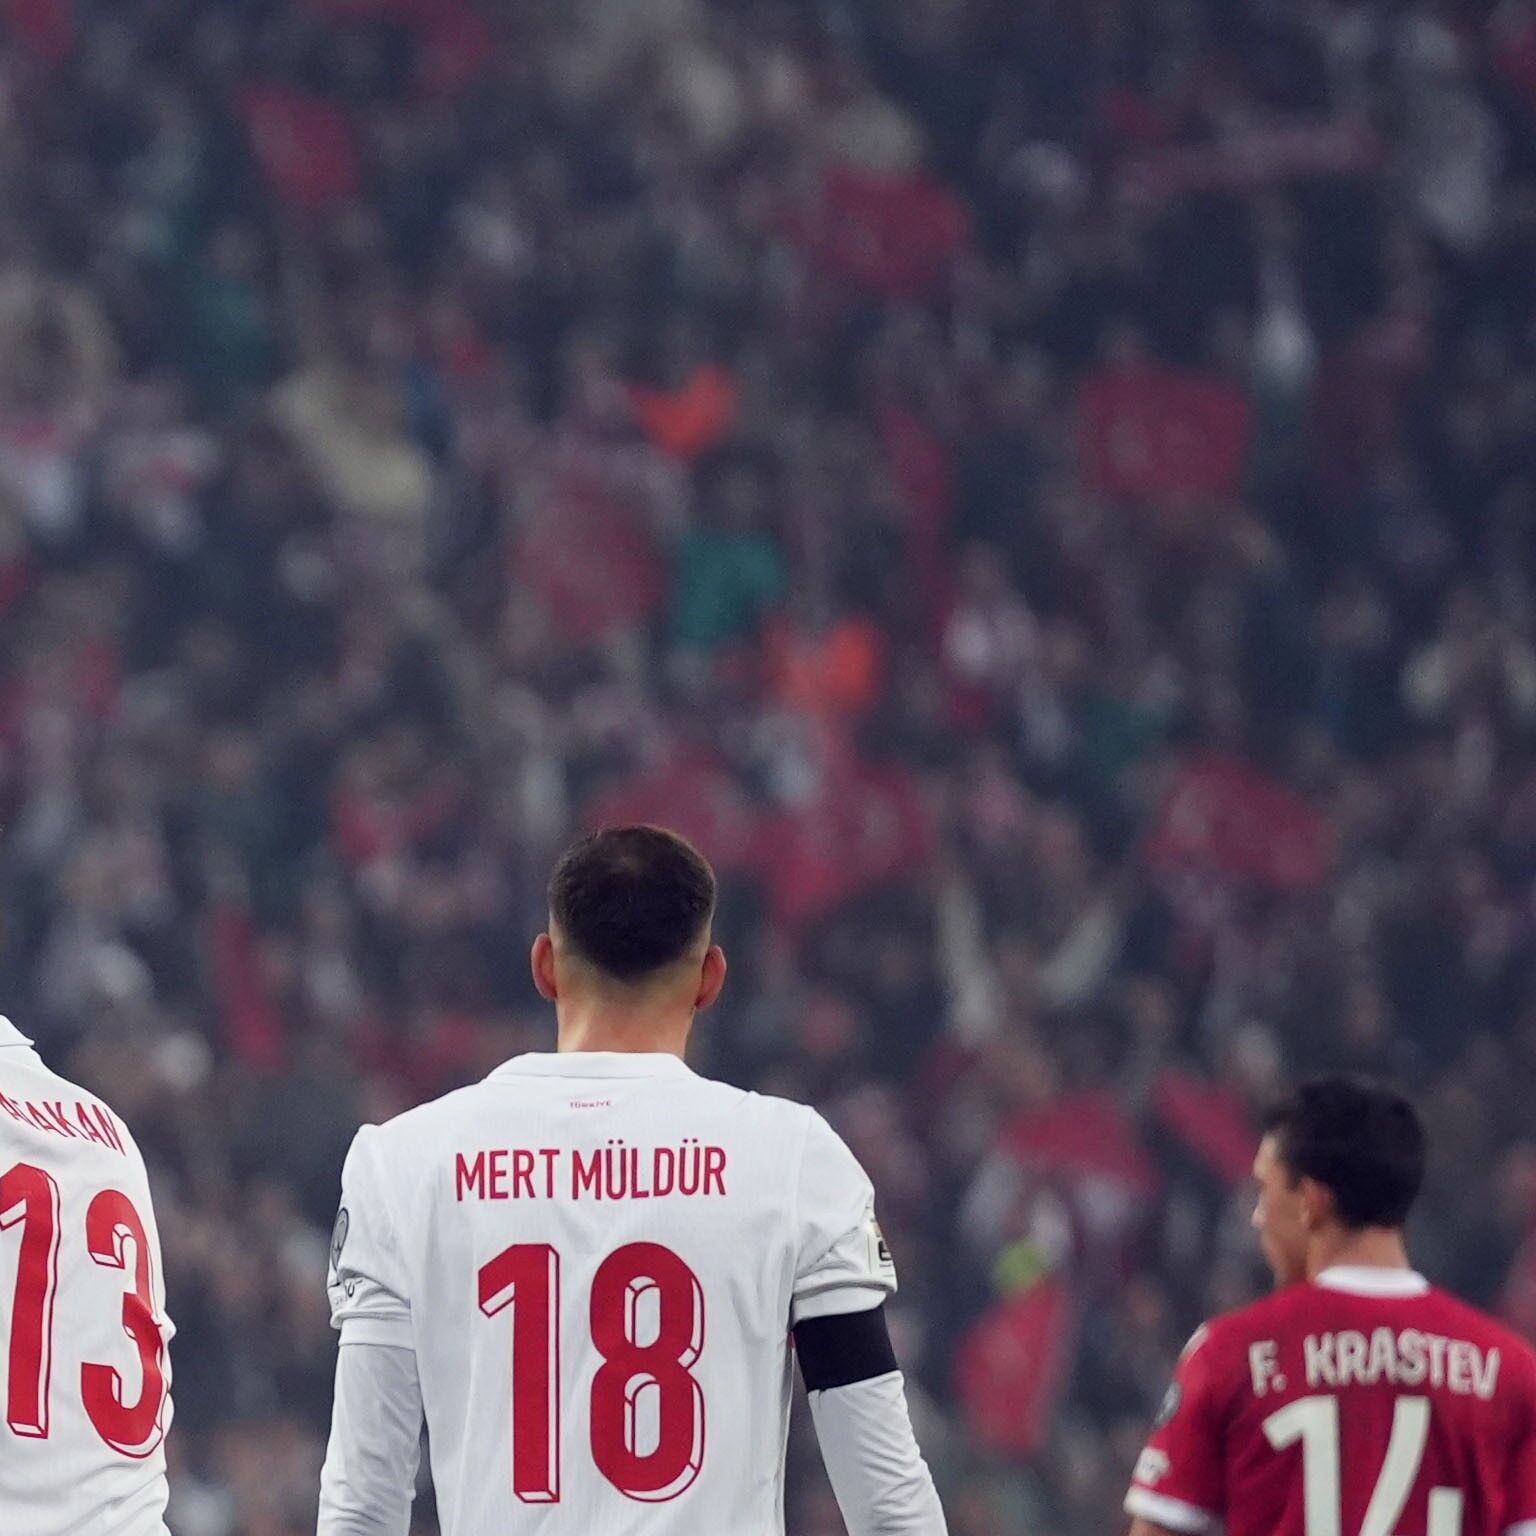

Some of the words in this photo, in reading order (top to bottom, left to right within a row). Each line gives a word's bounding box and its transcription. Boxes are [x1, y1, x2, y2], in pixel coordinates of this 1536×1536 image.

[456, 1148, 562, 1201] MERT
[571, 1138, 728, 1201] MÜLDÜR
[477, 1241, 706, 1504] 18
[1249, 1340, 1288, 1397] F.
[1304, 1327, 1502, 1400] KRASTEV
